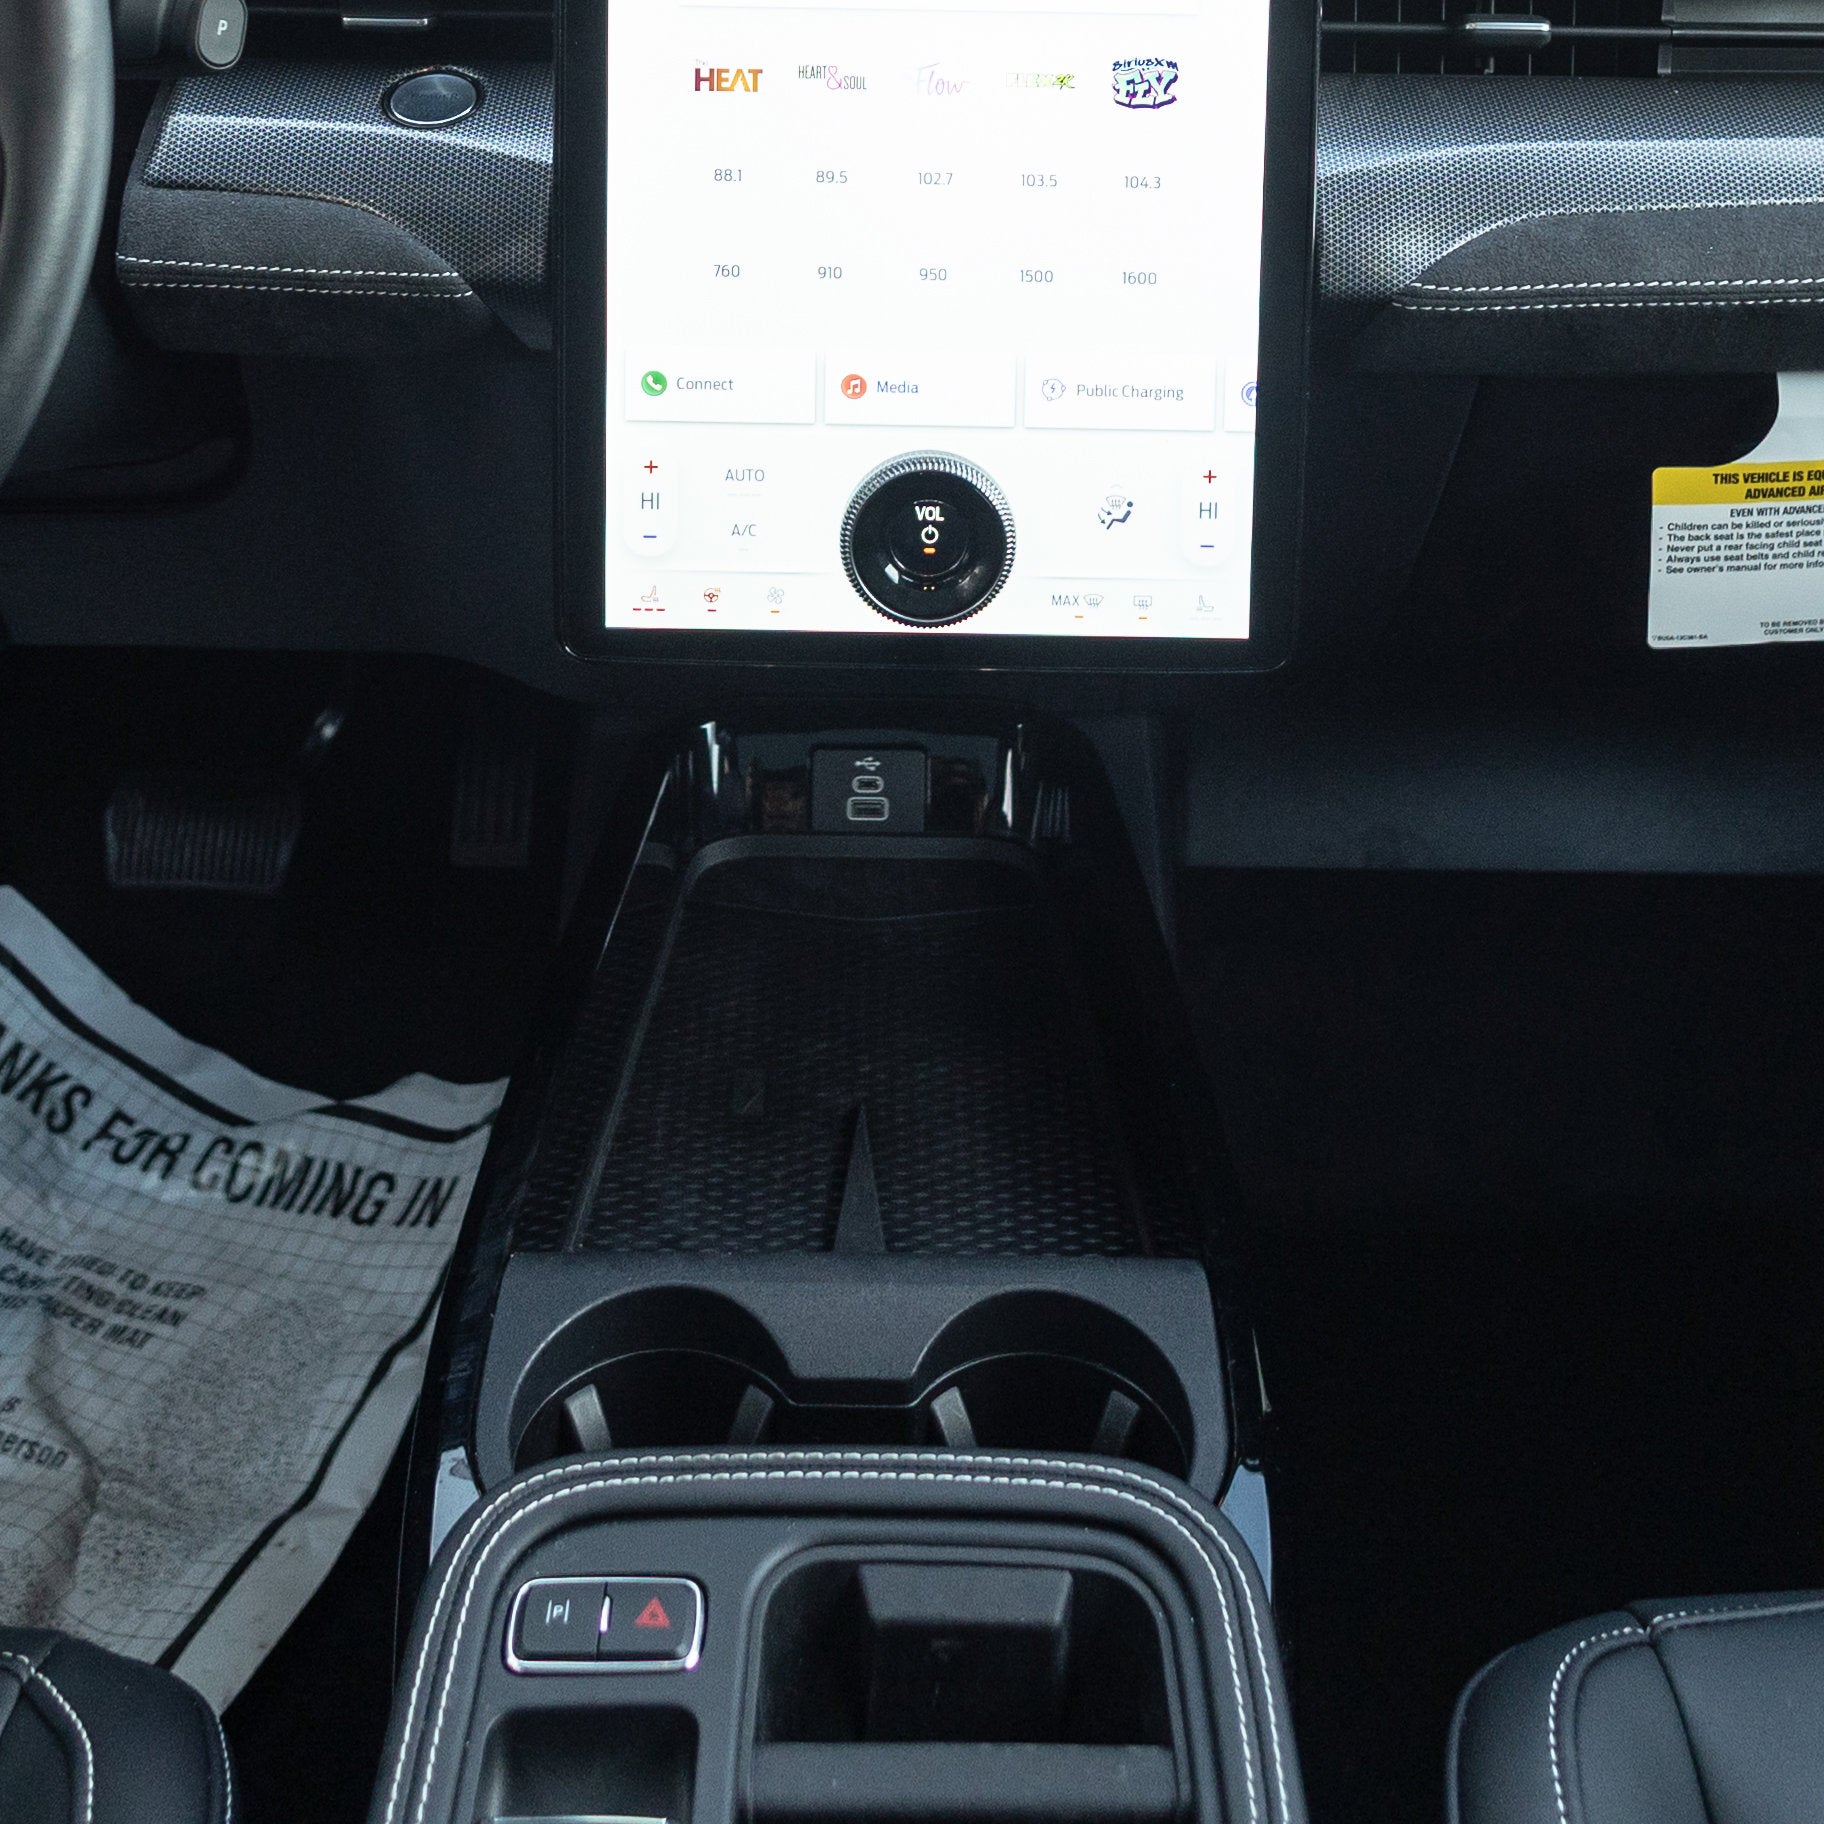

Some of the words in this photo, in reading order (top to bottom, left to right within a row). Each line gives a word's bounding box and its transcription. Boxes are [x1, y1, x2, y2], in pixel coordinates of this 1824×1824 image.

[216, 19, 228, 35] P
[694, 67, 764, 93] HEAT
[713, 168, 743, 183] 88.1
[815, 170, 849, 185] 89.5
[917, 171, 953, 187] 102.7
[1019, 172, 1058, 188] 103.5
[1123, 174, 1162, 190] 104.3
[712, 263, 741, 279] 760
[816, 265, 843, 280] 910
[918, 267, 948, 282] 950
[1019, 268, 1054, 284] 1500
[1121, 270, 1158, 286] 1600
[676, 376, 734, 392] Connect
[876, 379, 919, 395] Media
[1076, 382, 1118, 399] Public
[1121, 384, 1184, 403] Charging
[724, 467, 766, 483] AUTO
[1712, 472, 1740, 485] THIS
[1742, 471, 1790, 484] VEHICLE
[1792, 470, 1804, 482] IS
[1744, 486, 1806, 500] ADVANCED
[640, 491, 661, 511] HI
[1199, 500, 1218, 521] HI
[915, 504, 945, 523] VOL
[1729, 508, 1754, 518] EVEN
[1756, 507, 1780, 517] WITH
[731, 521, 757, 539] A/C
[1667, 522, 1709, 532] Children
[1745, 520, 1771, 529] killed
[1687, 532, 1711, 542] back
[1713, 532, 1734, 541] seat
[1764, 529, 1793, 539] safest
[1795, 528, 1821, 539] place
[1666, 543, 1695, 553] Never
[1745, 541, 1775, 551] facing
[1777, 540, 1801, 549] child
[1666, 554, 1701, 564] Always
[1746, 552, 1770, 561] belts
[1791, 549, 1815, 559] child
[1686, 564, 1724, 574] owner's
[1726, 562, 1762, 572] manual
[1779, 560, 1804, 569] more
[1051, 593, 1080, 608] MAX
[191, 1134, 397, 1227] COMING
[393, 1174, 461, 1231] IN
